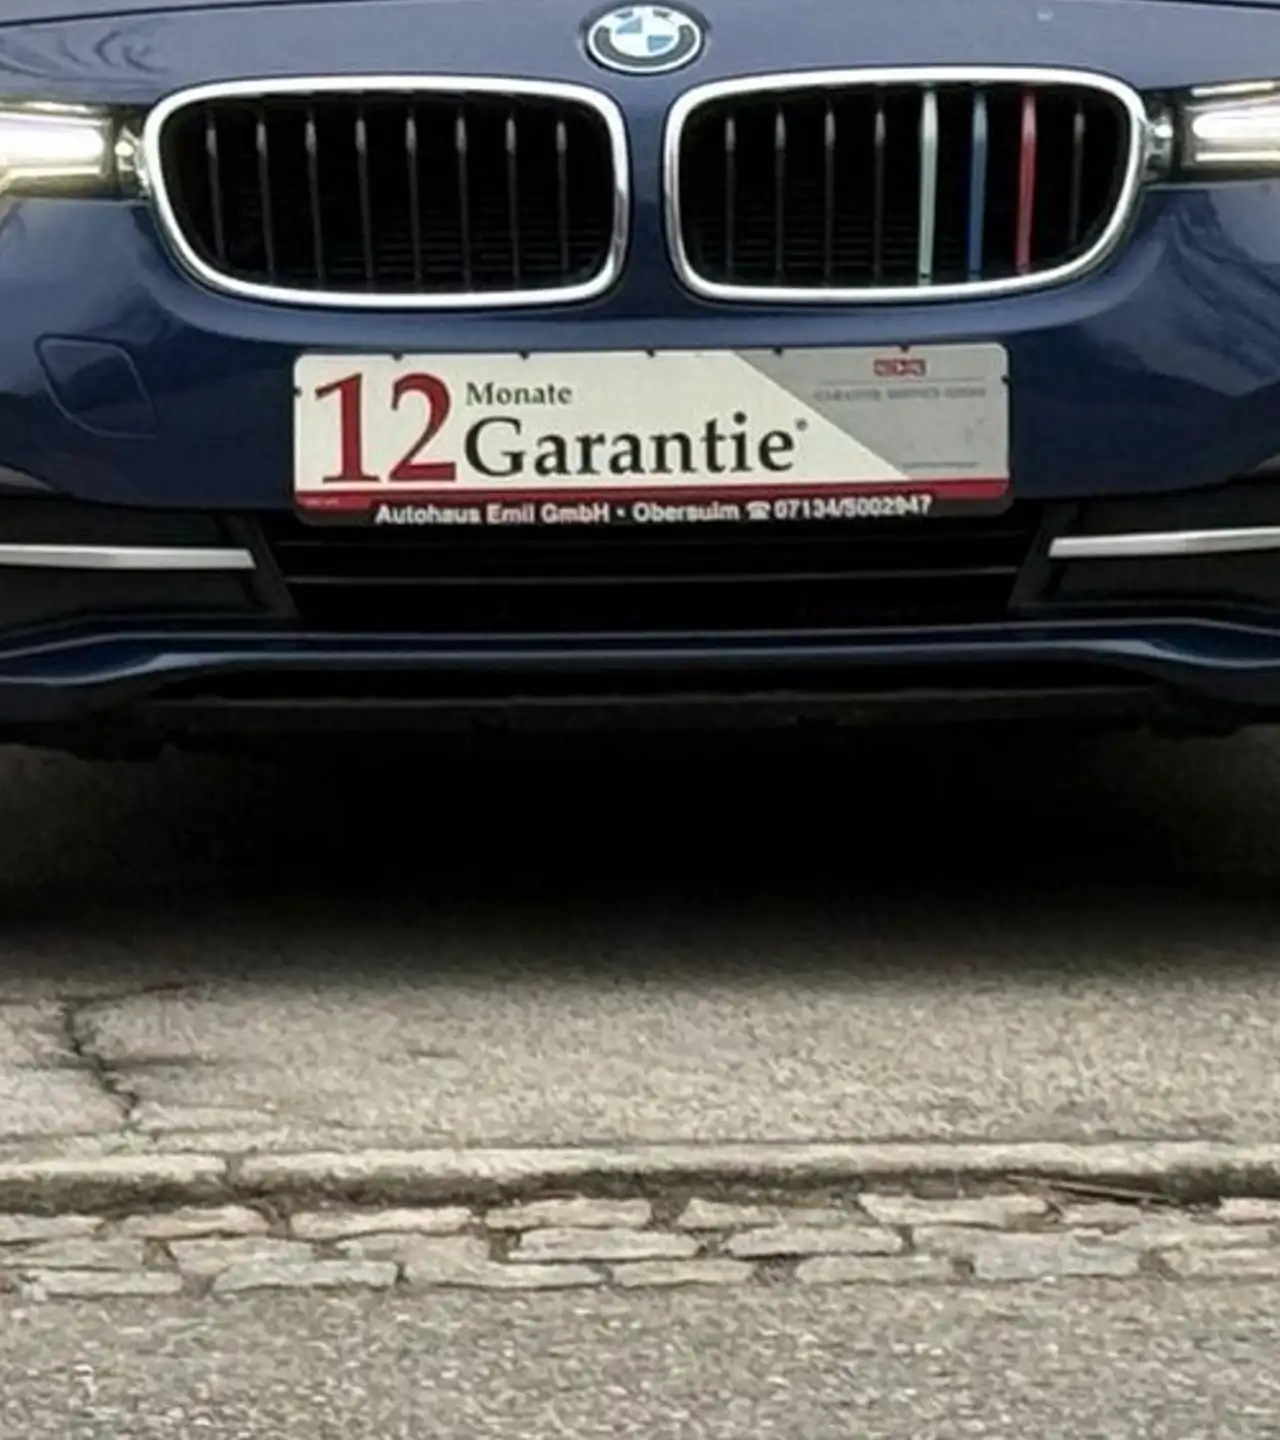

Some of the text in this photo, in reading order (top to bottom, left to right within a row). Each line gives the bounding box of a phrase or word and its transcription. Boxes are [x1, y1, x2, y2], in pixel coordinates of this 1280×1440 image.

[314, 371, 573, 483] 12 Monate
[375, 503, 481, 525] Autohaus
[486, 502, 535, 524] Emil
[540, 501, 610, 524] GmbH
[631, 499, 740, 523] Obersulm
